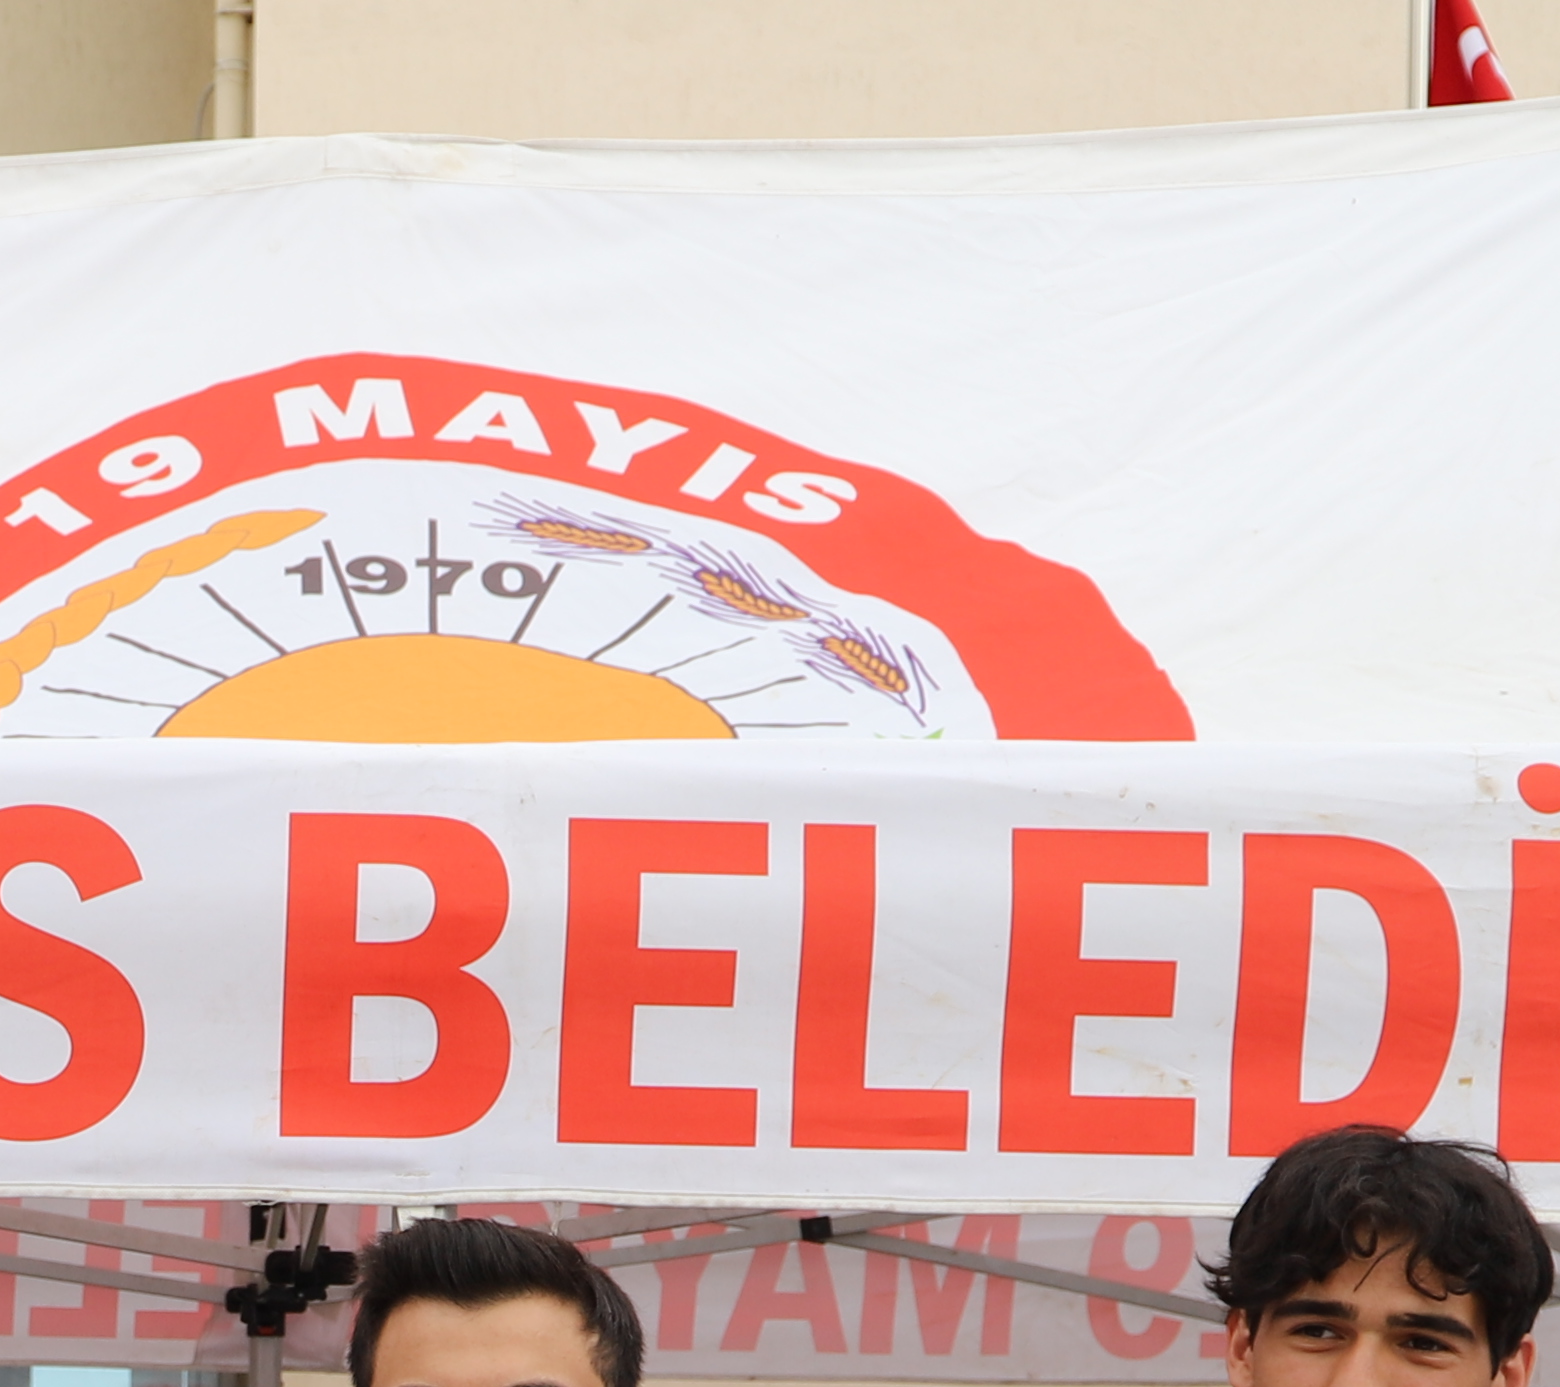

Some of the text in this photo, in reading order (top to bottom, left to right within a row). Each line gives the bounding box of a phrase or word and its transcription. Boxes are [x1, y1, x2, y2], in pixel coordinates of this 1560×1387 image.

[4, 377, 858, 537] 19 MAYIS
[284, 555, 546, 597] 1970
